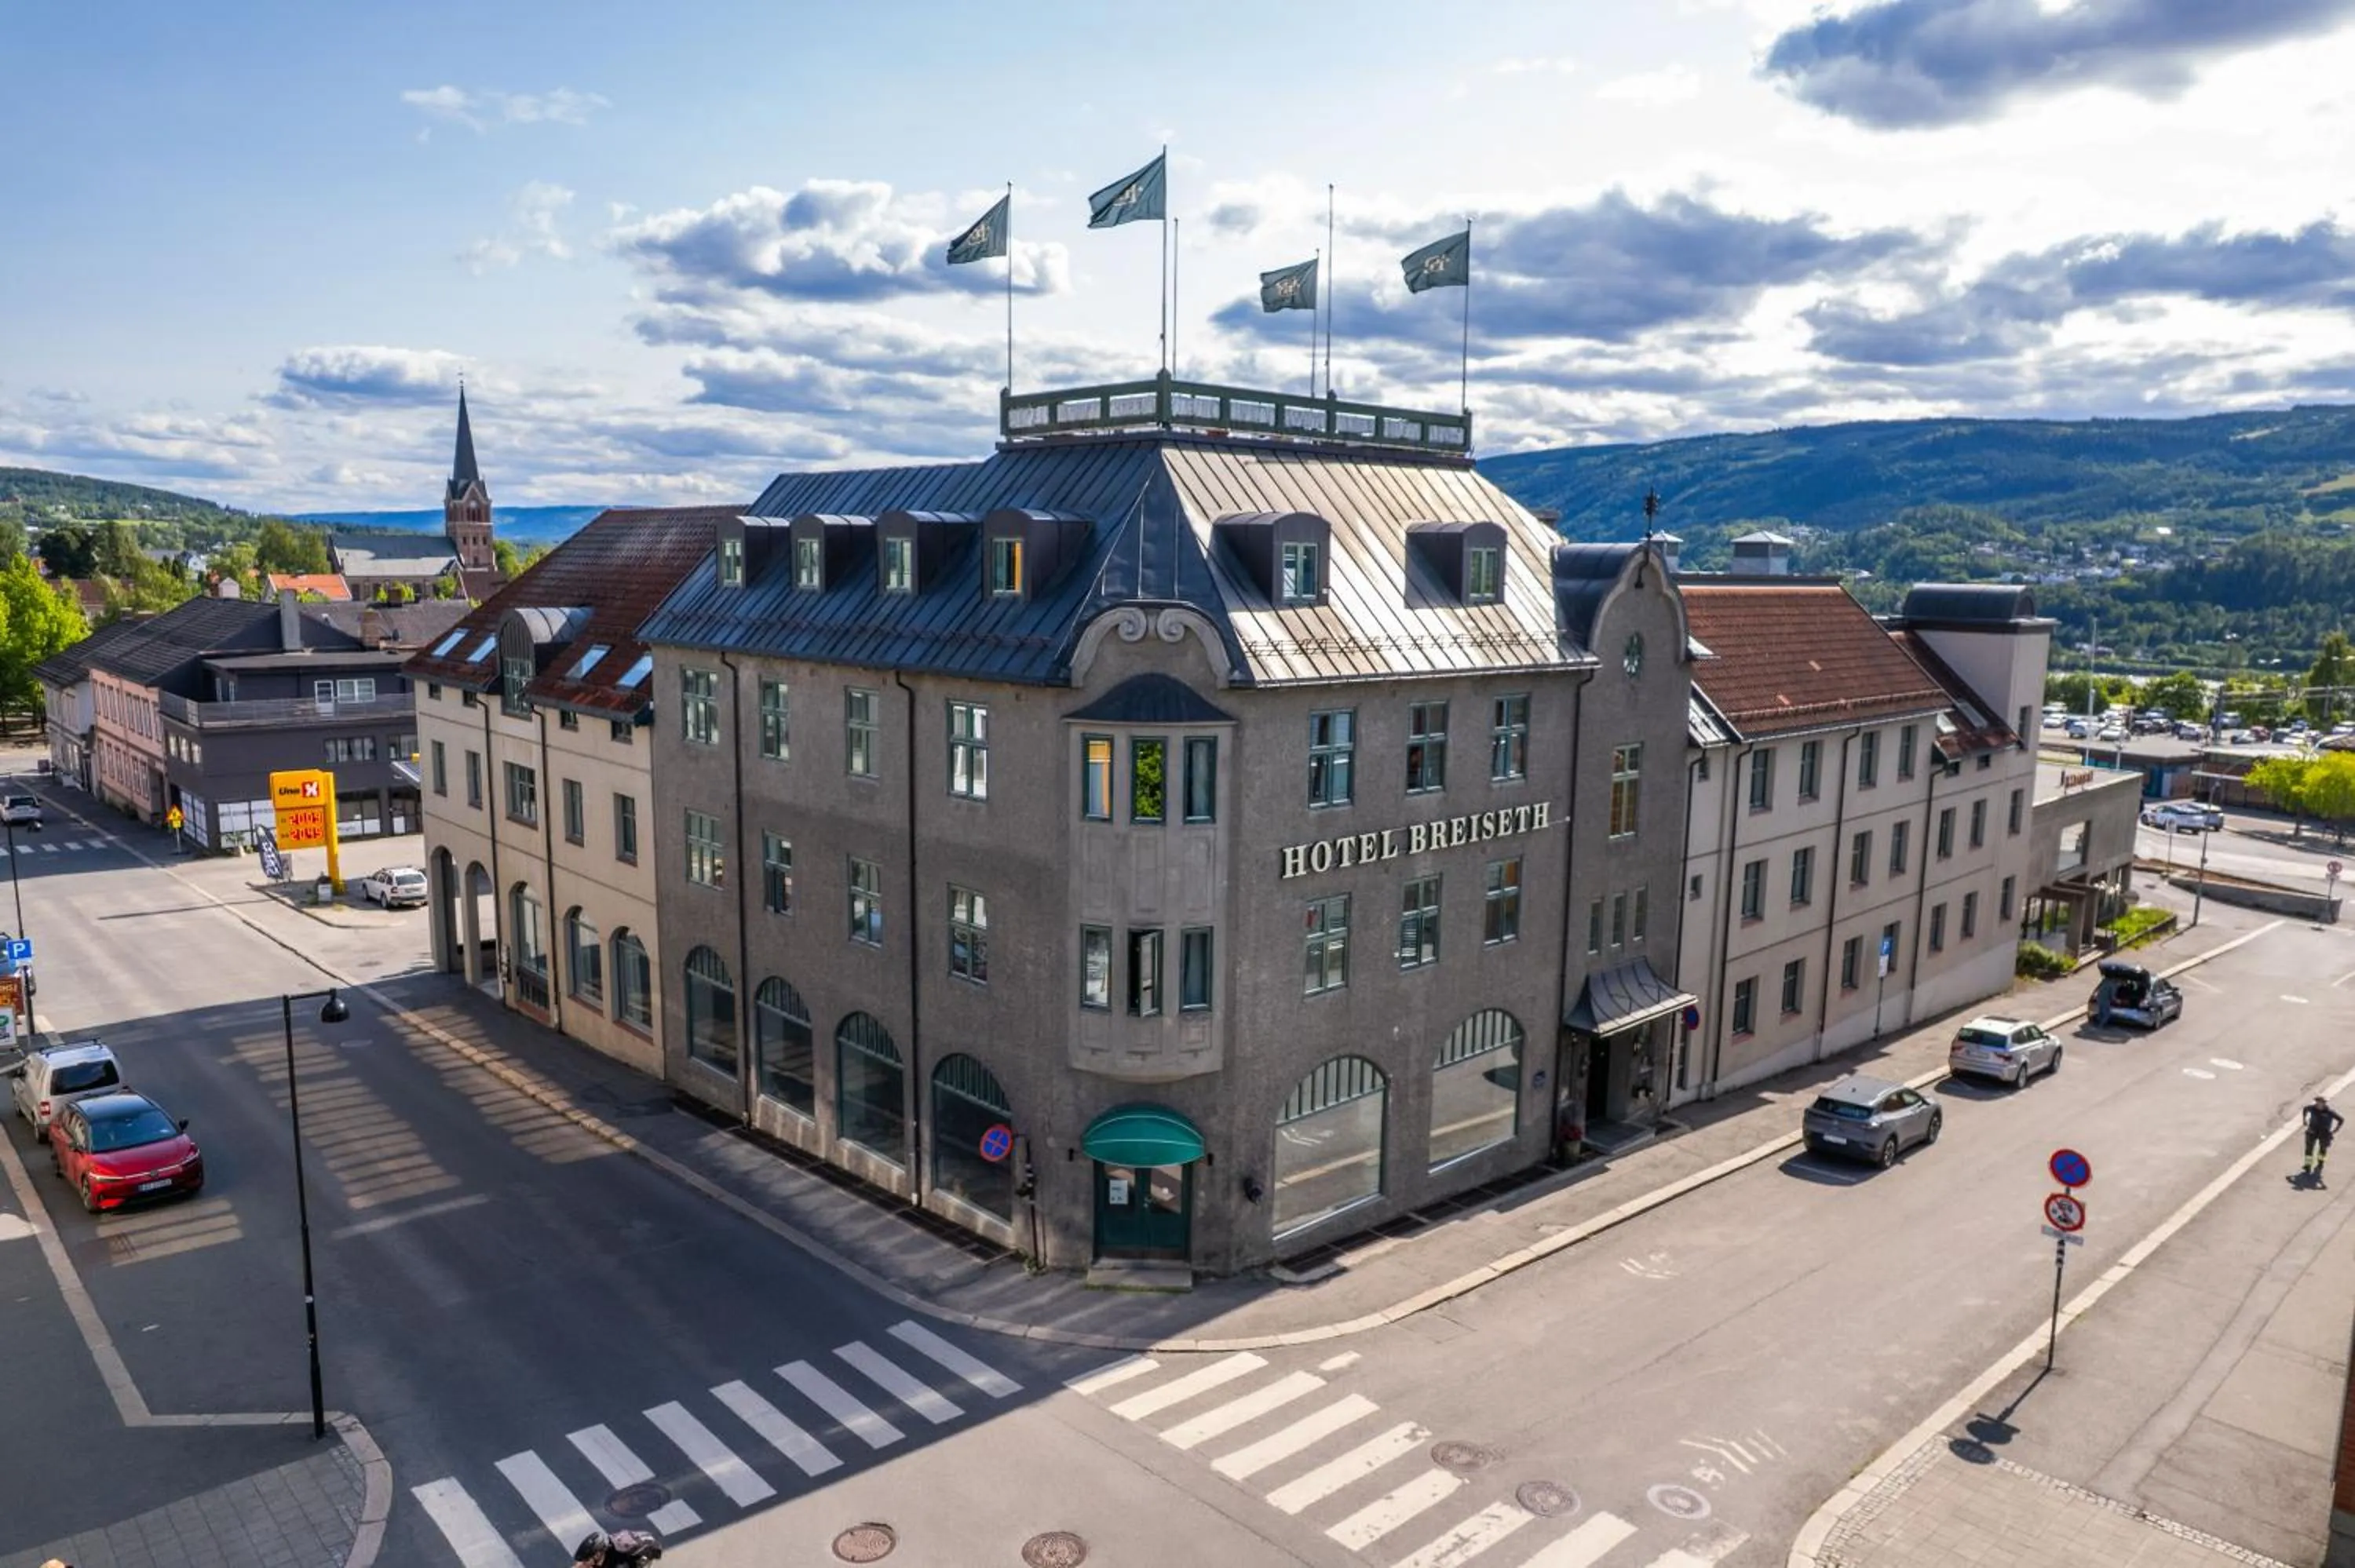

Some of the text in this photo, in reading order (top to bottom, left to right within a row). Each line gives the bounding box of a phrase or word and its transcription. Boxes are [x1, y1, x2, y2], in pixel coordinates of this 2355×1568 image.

[1282, 802, 1550, 879] HOTEL BREISETH
[13, 943, 25, 957] P
